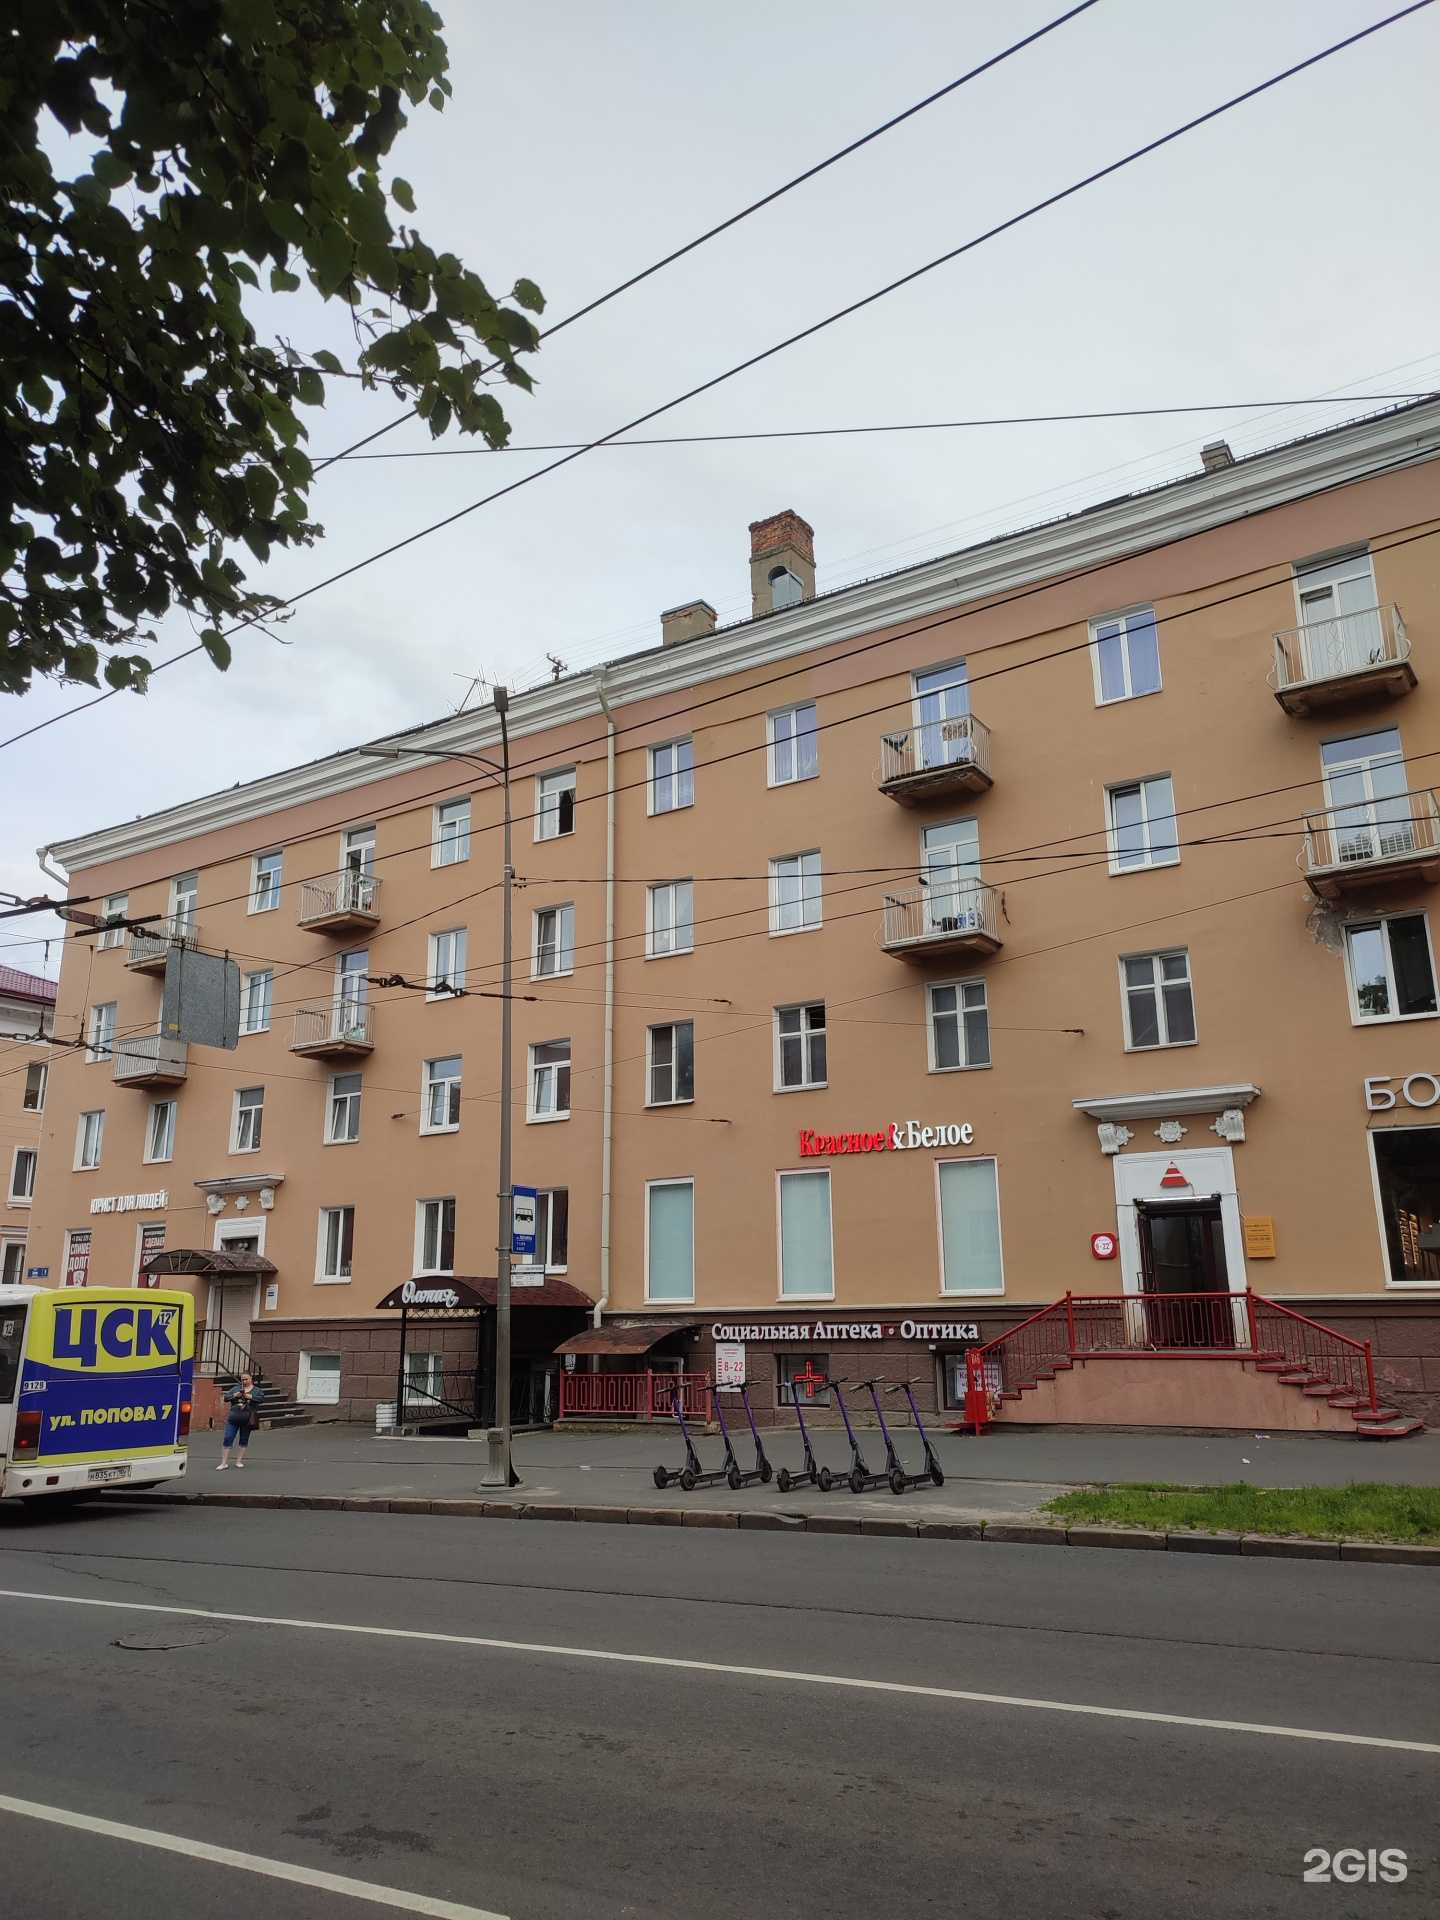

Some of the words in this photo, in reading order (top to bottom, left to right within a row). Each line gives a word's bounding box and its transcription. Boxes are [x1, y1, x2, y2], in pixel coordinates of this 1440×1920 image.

[1364, 1072, 1440, 1110] БО
[90, 1196, 117, 1214] ЮРИСТ
[116, 1195, 135, 1212] ДЛЯ
[135, 1189, 166, 1210] ЛЮДЕЙ
[159, 1313, 171, 1325] 12
[711, 1323, 810, 1342] Социальная
[813, 1320, 883, 1339] Аптека
[900, 1319, 979, 1339] Оптика
[53, 1308, 177, 1367] ЦСК
[50, 1414, 76, 1431] ул.
[80, 1406, 157, 1425] ПОПОВА
[162, 1405, 173, 1419] 7
